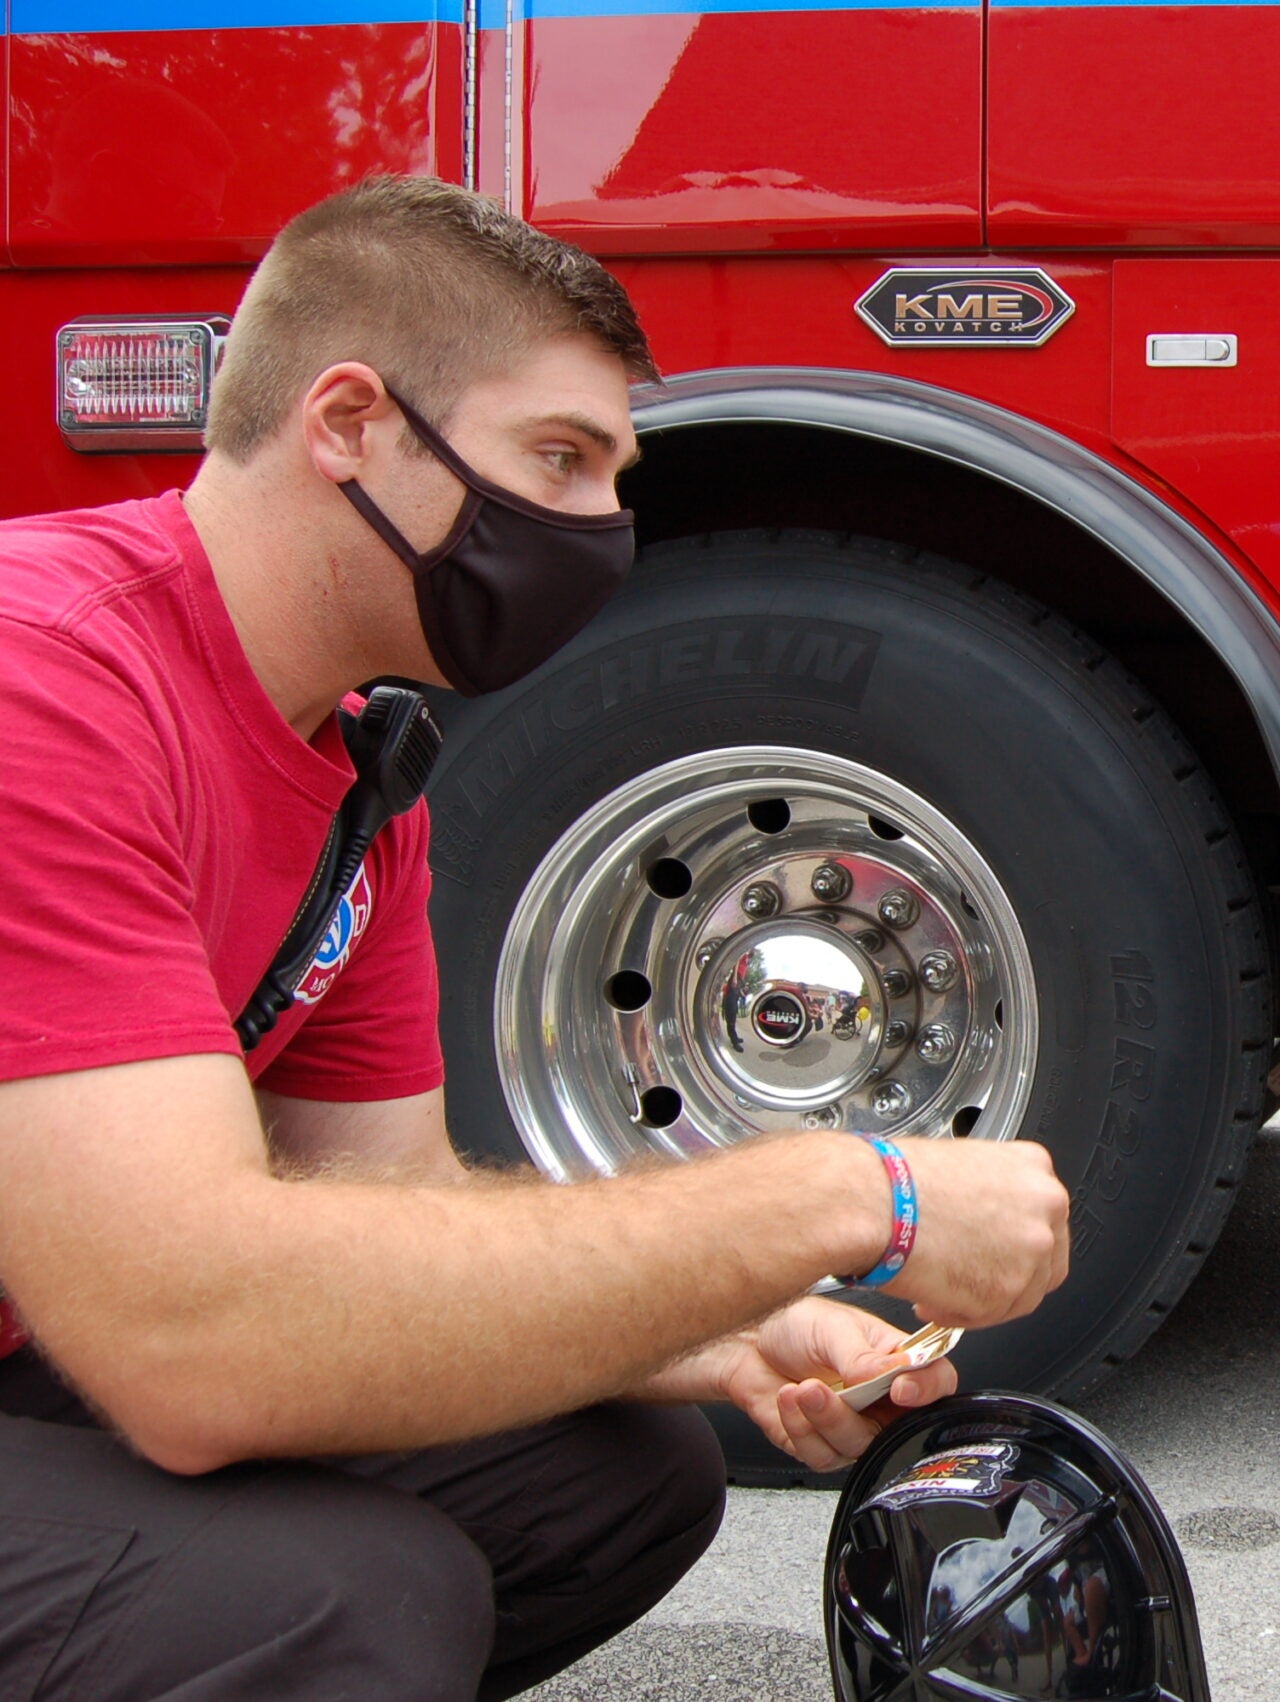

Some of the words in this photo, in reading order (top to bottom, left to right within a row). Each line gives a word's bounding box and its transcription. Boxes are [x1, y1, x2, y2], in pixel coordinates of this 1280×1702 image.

[895, 294, 1023, 318] KME
[894, 322, 1023, 332] KOVATCH
[456, 628, 868, 818] MICHELIN
[766, 1014, 800, 1024] KME
